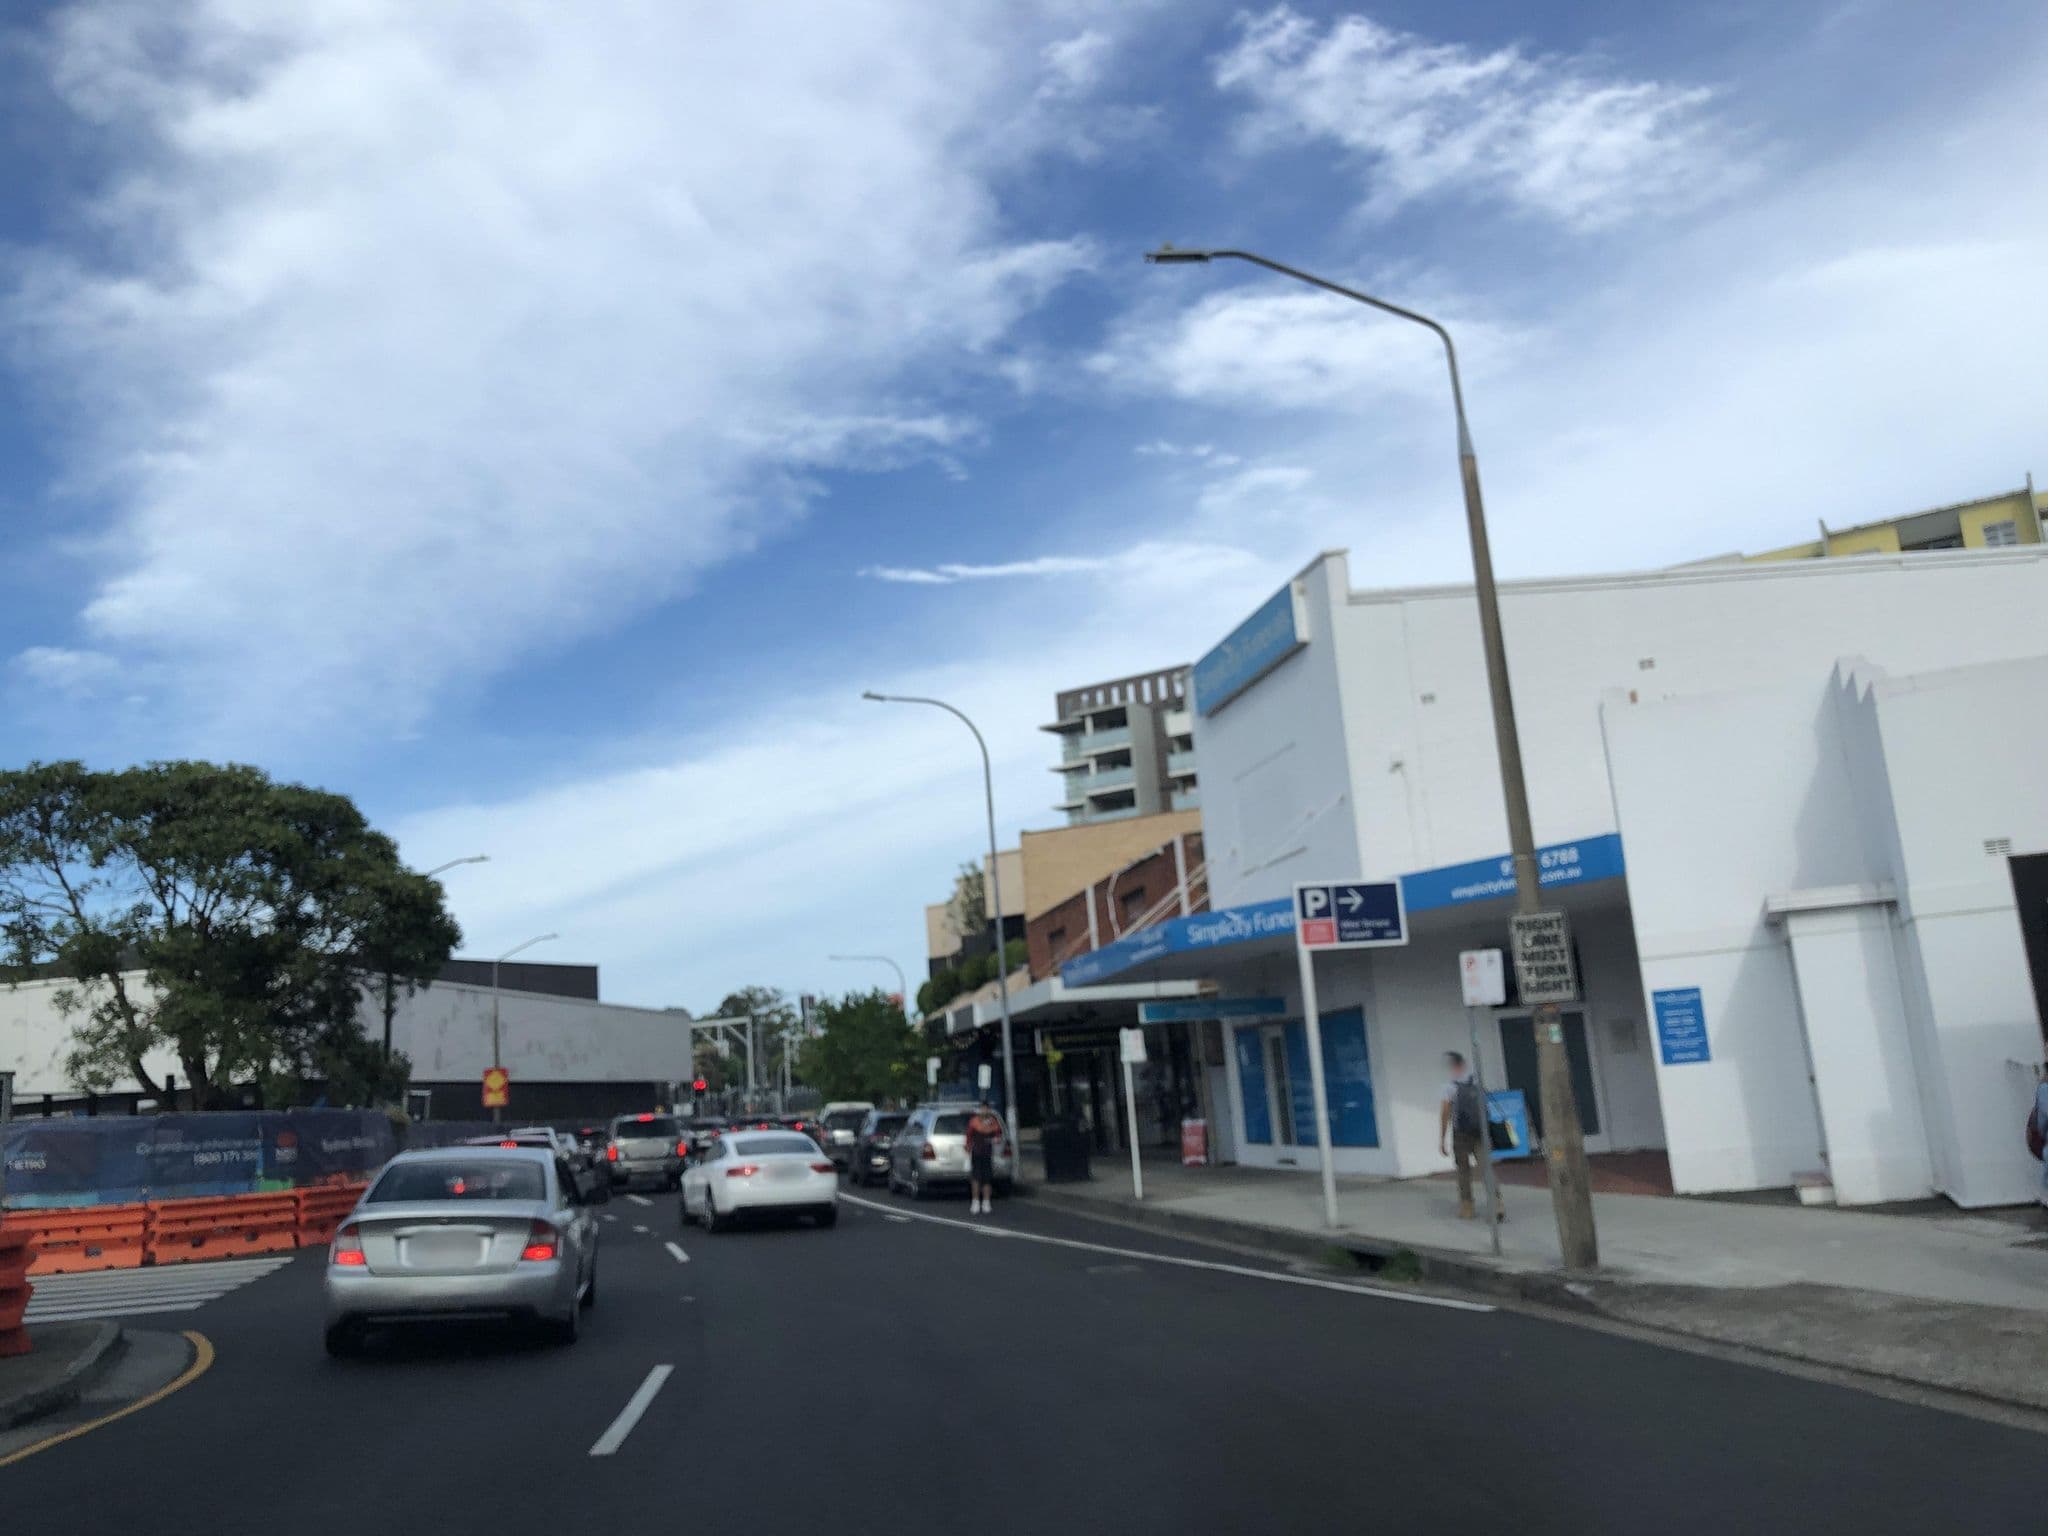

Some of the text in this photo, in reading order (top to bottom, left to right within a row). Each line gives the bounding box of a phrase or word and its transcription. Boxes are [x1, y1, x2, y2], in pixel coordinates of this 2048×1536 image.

[1540, 847, 1580, 869] 6788
[1303, 888, 1329, 918] P
[1187, 910, 1251, 944] Simplicity
[1515, 919, 1562, 931] RIGHT
[1520, 948, 1566, 962] MUST
[1524, 965, 1568, 979] TURN
[1525, 979, 1572, 993] RIGHT
